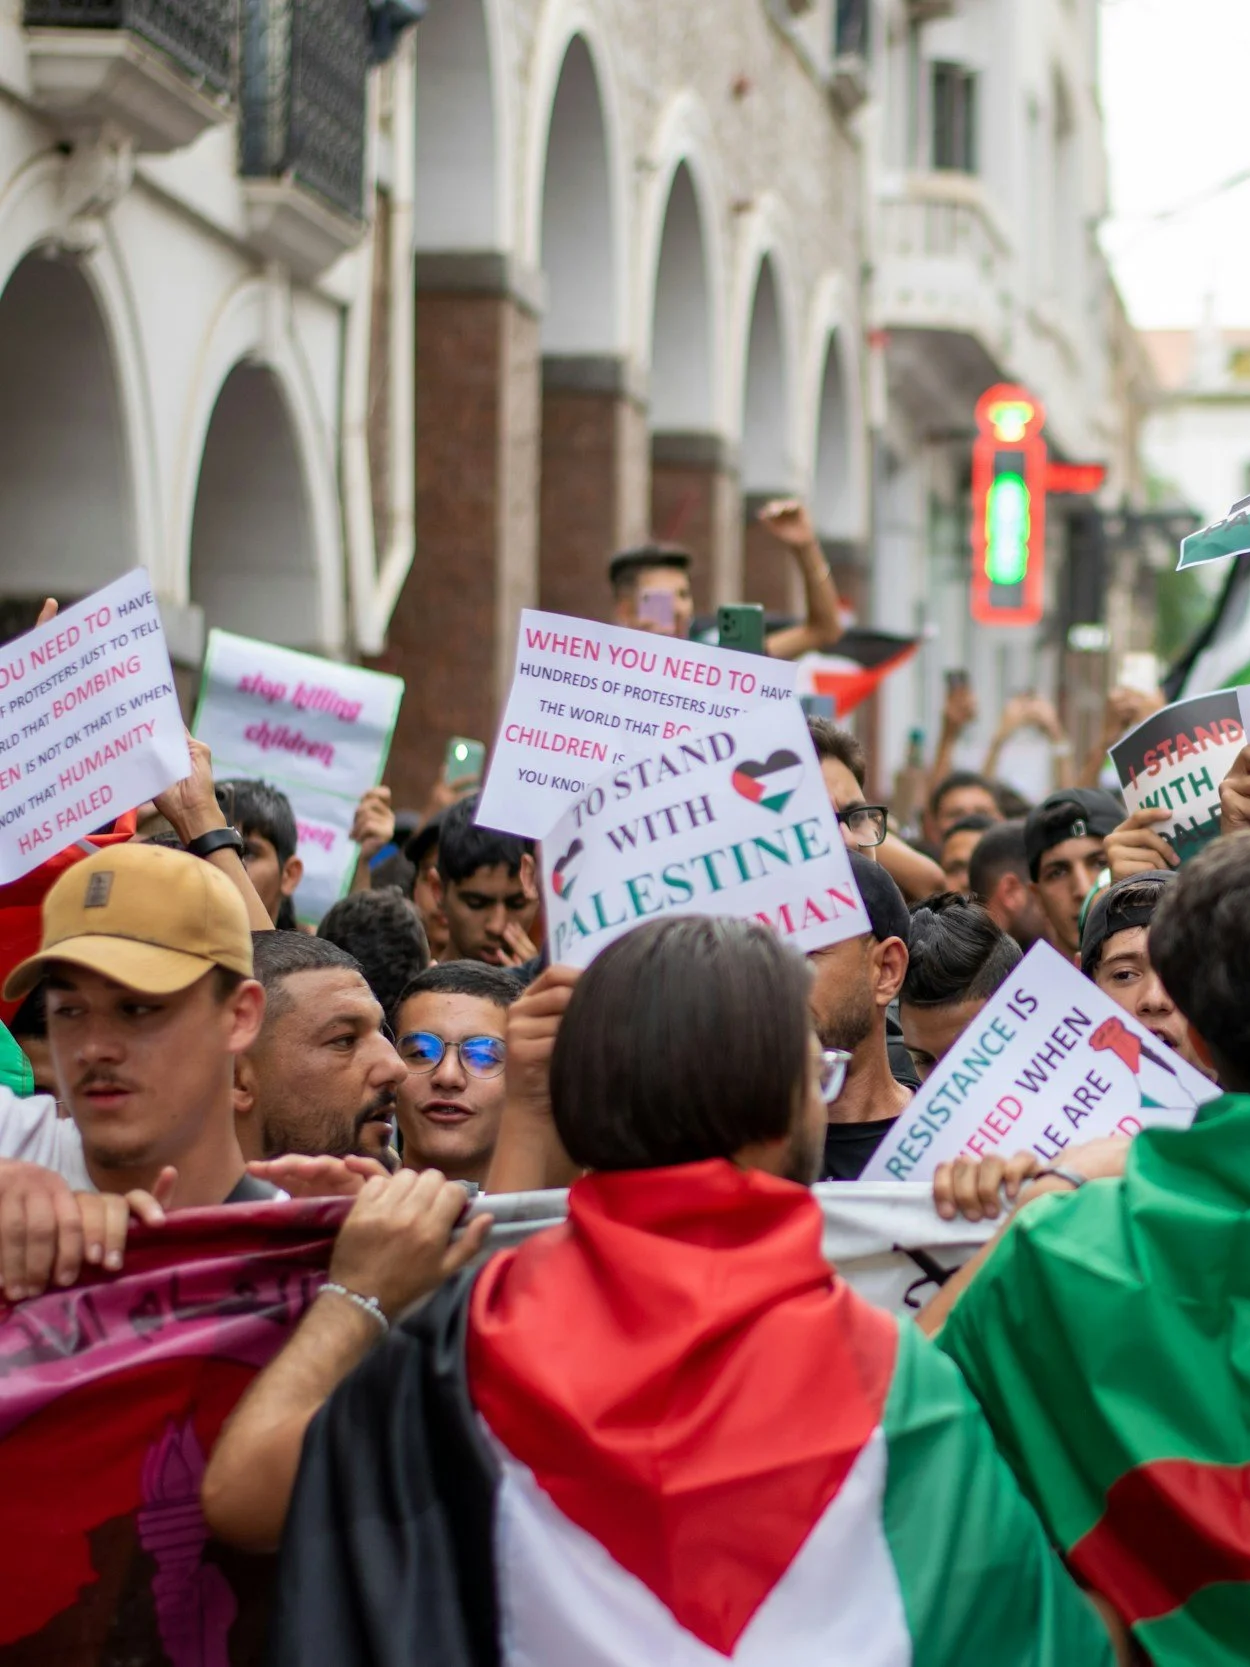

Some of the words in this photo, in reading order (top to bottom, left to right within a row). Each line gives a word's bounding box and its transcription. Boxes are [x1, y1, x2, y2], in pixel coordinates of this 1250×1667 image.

[0, 658, 25, 689] OU
[30, 626, 81, 670] NEED
[84, 606, 112, 634] TO
[117, 591, 154, 618] HAVE
[9, 661, 79, 714] PROTESTERS
[80, 643, 108, 670] JUST
[110, 633, 129, 651] TO
[131, 618, 161, 641] TELL
[526, 628, 600, 662] WHEN
[608, 644, 657, 673] YOU
[662, 656, 722, 688] NEED
[728, 669, 757, 694] TO
[760, 684, 793, 701] HAVE
[0, 732, 20, 752] RLD
[21, 712, 50, 739] THAT
[52, 655, 142, 720] BOMBING
[237, 672, 287, 703] stop
[291, 680, 363, 724] killing
[519, 662, 598, 690] HUNDREDS
[602, 680, 621, 695] OF
[624, 685, 706, 714] PROTESTERS
[708, 703, 740, 719] JUST
[540, 700, 565, 717] THE
[570, 706, 621, 728] WORLD
[625, 718, 660, 737] THAT
[25, 760, 36, 775] IS
[37, 742, 62, 767] NOT
[64, 731, 82, 750] OK
[83, 710, 113, 737] THAT
[115, 703, 128, 719] IS
[129, 682, 173, 710] WHEN
[243, 720, 336, 768] children
[505, 724, 608, 762] CHILDREN
[1128, 765, 1138, 791] I
[1143, 718, 1244, 778] STAND
[0, 802, 26, 827] NOW
[28, 783, 57, 809] THAT
[58, 719, 156, 790] HUMANITY
[518, 768, 548, 786] YOU
[551, 776, 587, 793] KNO
[572, 786, 606, 829] TO
[613, 731, 737, 800] STAND
[1139, 766, 1214, 810] WITH
[17, 820, 54, 856] HAS
[55, 784, 114, 832] FAILED
[605, 794, 717, 854] WITH
[554, 817, 831, 961] PALESTINE
[746, 882, 858, 935] MAN
[885, 1016, 1016, 1182] RESISTANCE
[1005, 988, 1039, 1022] IS
[1014, 1007, 1092, 1095] WHEN
[1062, 1069, 1112, 1129] ARE
